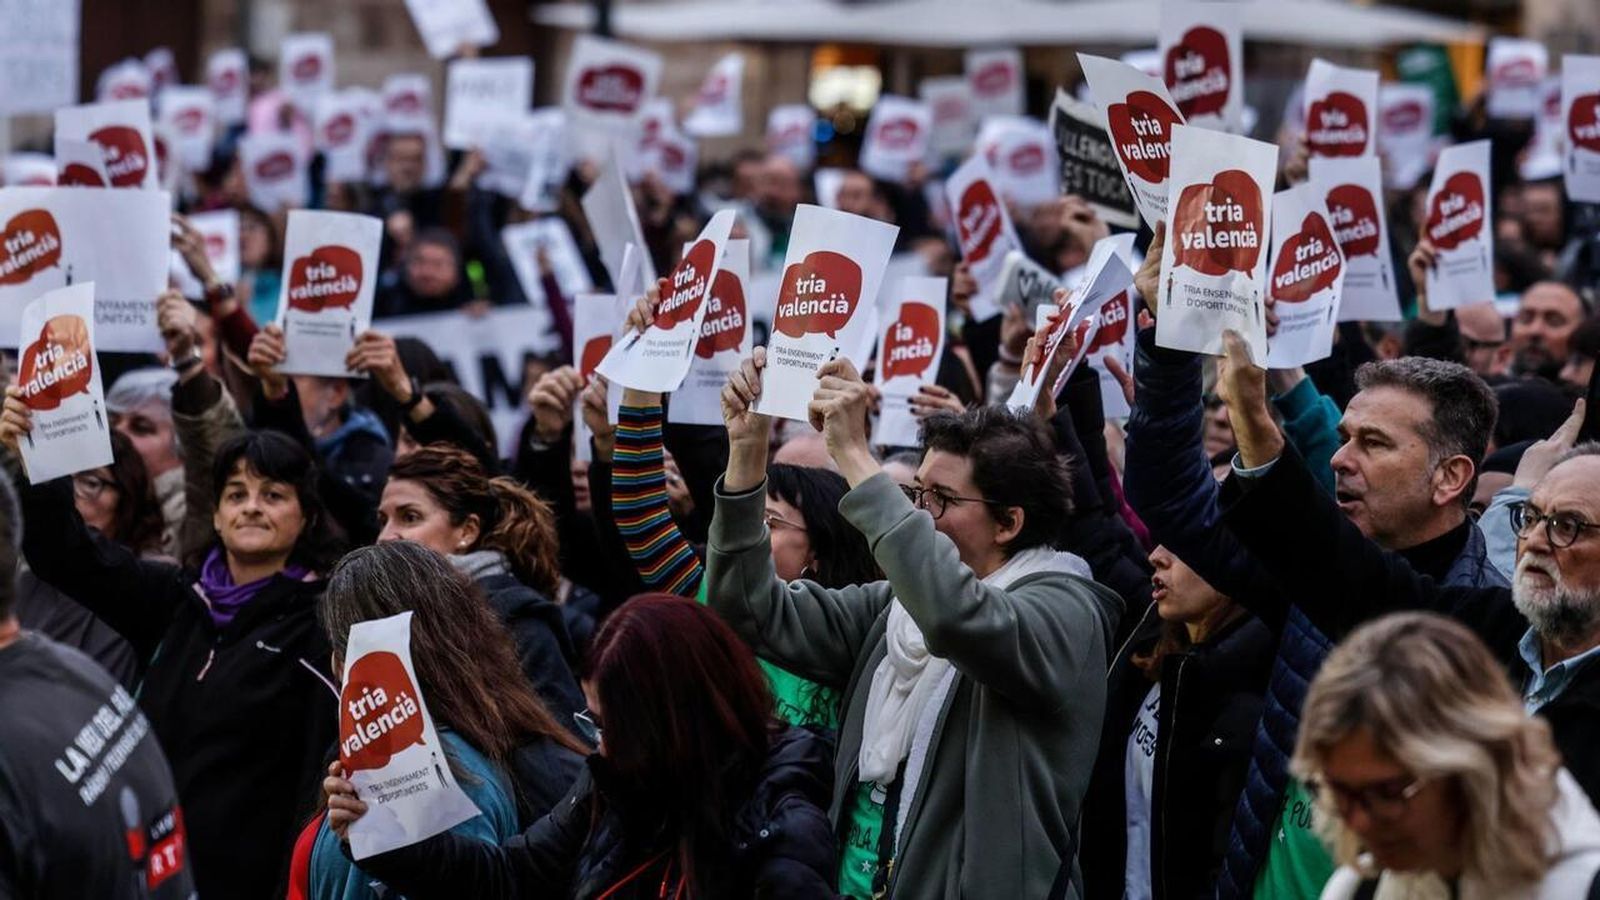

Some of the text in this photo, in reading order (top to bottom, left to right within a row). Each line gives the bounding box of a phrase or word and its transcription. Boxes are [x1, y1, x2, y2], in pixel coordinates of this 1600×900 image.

[1131, 113, 1163, 137] tria
[1122, 138, 1170, 160] valenc
[1204, 198, 1244, 224] tria
[4, 230, 35, 254] tria
[1182, 222, 1258, 250] valencià
[1295, 238, 1322, 263] tria
[305, 261, 337, 281] tria
[675, 263, 696, 288] tria
[1275, 246, 1339, 289] valencià
[290, 275, 358, 300] valencià
[659, 276, 705, 315] valencià
[796, 273, 827, 295] tria
[1184, 285, 1201, 295] TRIA
[708, 296, 722, 315] ia
[779, 293, 850, 318] valencià
[895, 322, 914, 342] ia
[36, 343, 65, 370] tria
[21, 350, 88, 399] valencià
[349, 687, 388, 721] tria
[342, 691, 418, 758] valencià
[54, 746, 91, 784] LA
